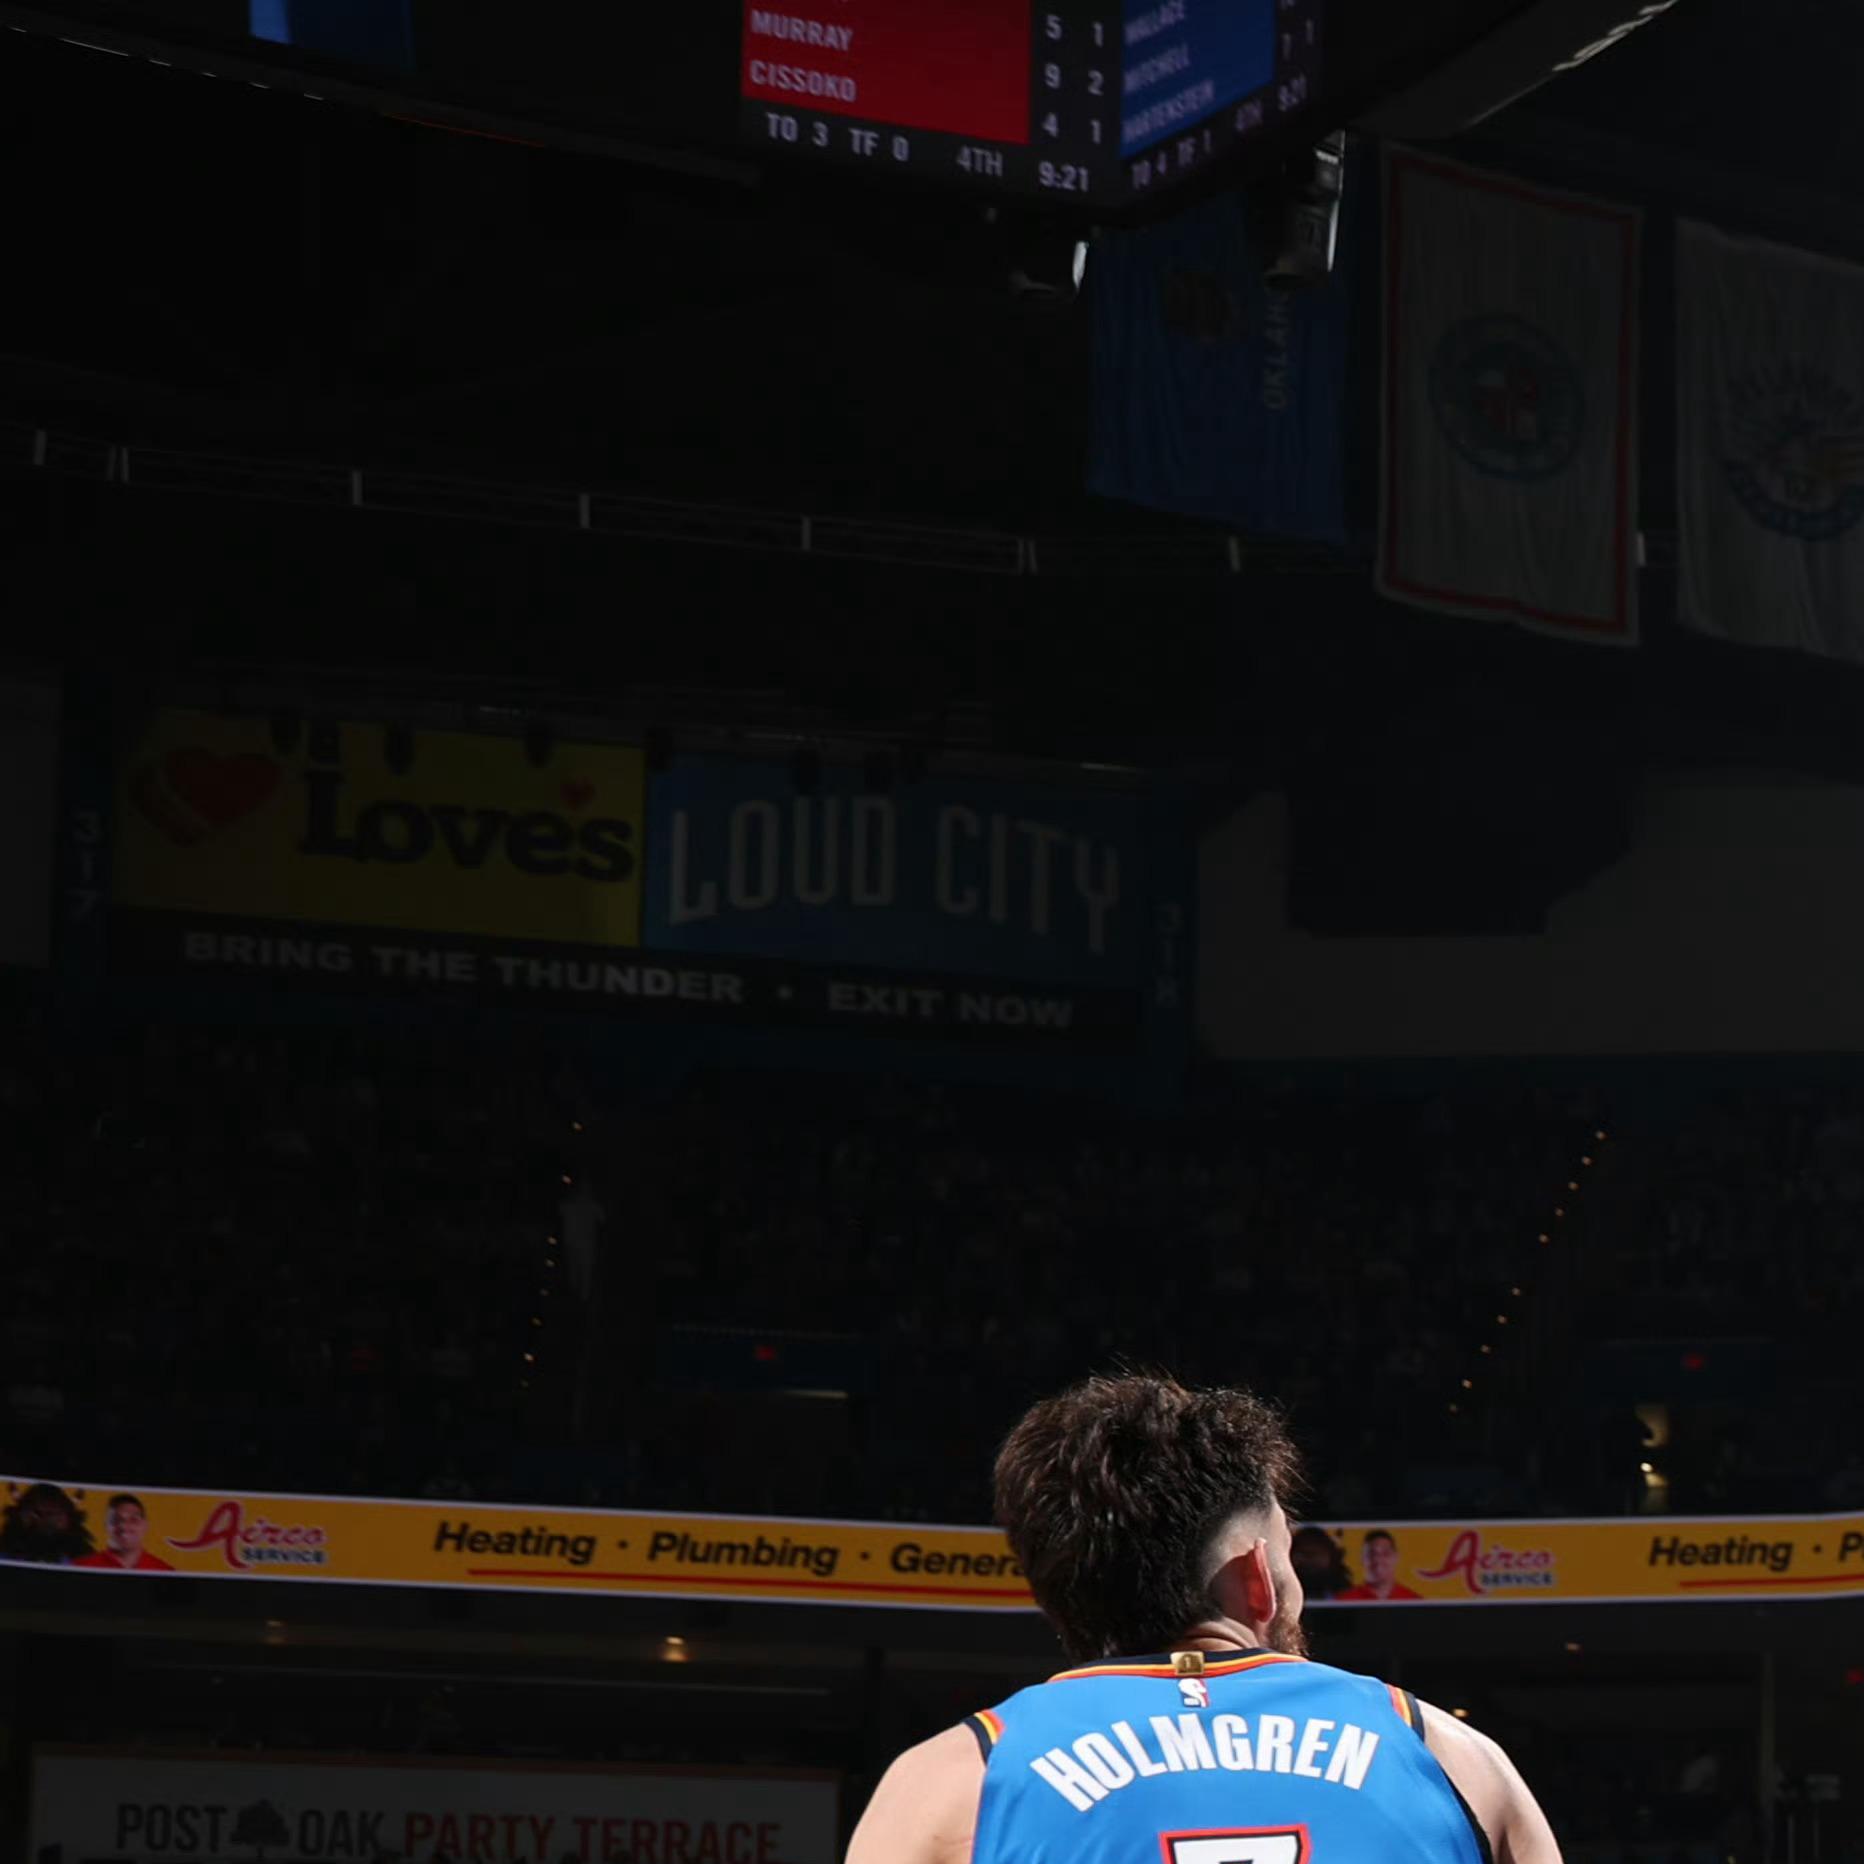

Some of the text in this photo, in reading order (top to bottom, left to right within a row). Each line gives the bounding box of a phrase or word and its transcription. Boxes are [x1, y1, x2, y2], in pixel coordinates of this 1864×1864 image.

[752, 9, 854, 51] MURRAY
[751, 59, 857, 103] CISSOKO
[766, 112, 798, 142] TO
[849, 127, 879, 157] TF
[956, 145, 1003, 178] 4TH
[1038, 160, 1090, 193] 9:21
[668, 794, 1121, 957] LOUD CITY
[182, 929, 1074, 1030] BRING THE THUNDER EXIT NOW
[167, 1501, 326, 1568] Airco
[242, 1547, 326, 1564] SERVICE
[434, 1522, 1026, 1579] Heating Plumbing Genera
[1418, 1530, 1556, 1593] Airco
[1648, 1535, 1794, 1572] Heating
[1481, 1571, 1556, 1588] SERVICE
[1030, 1713, 1380, 1813] HOLMGREN
[116, 1803, 229, 1853] POST
[299, 1811, 384, 1857] OAK
[405, 1814, 560, 1862] PARTY
